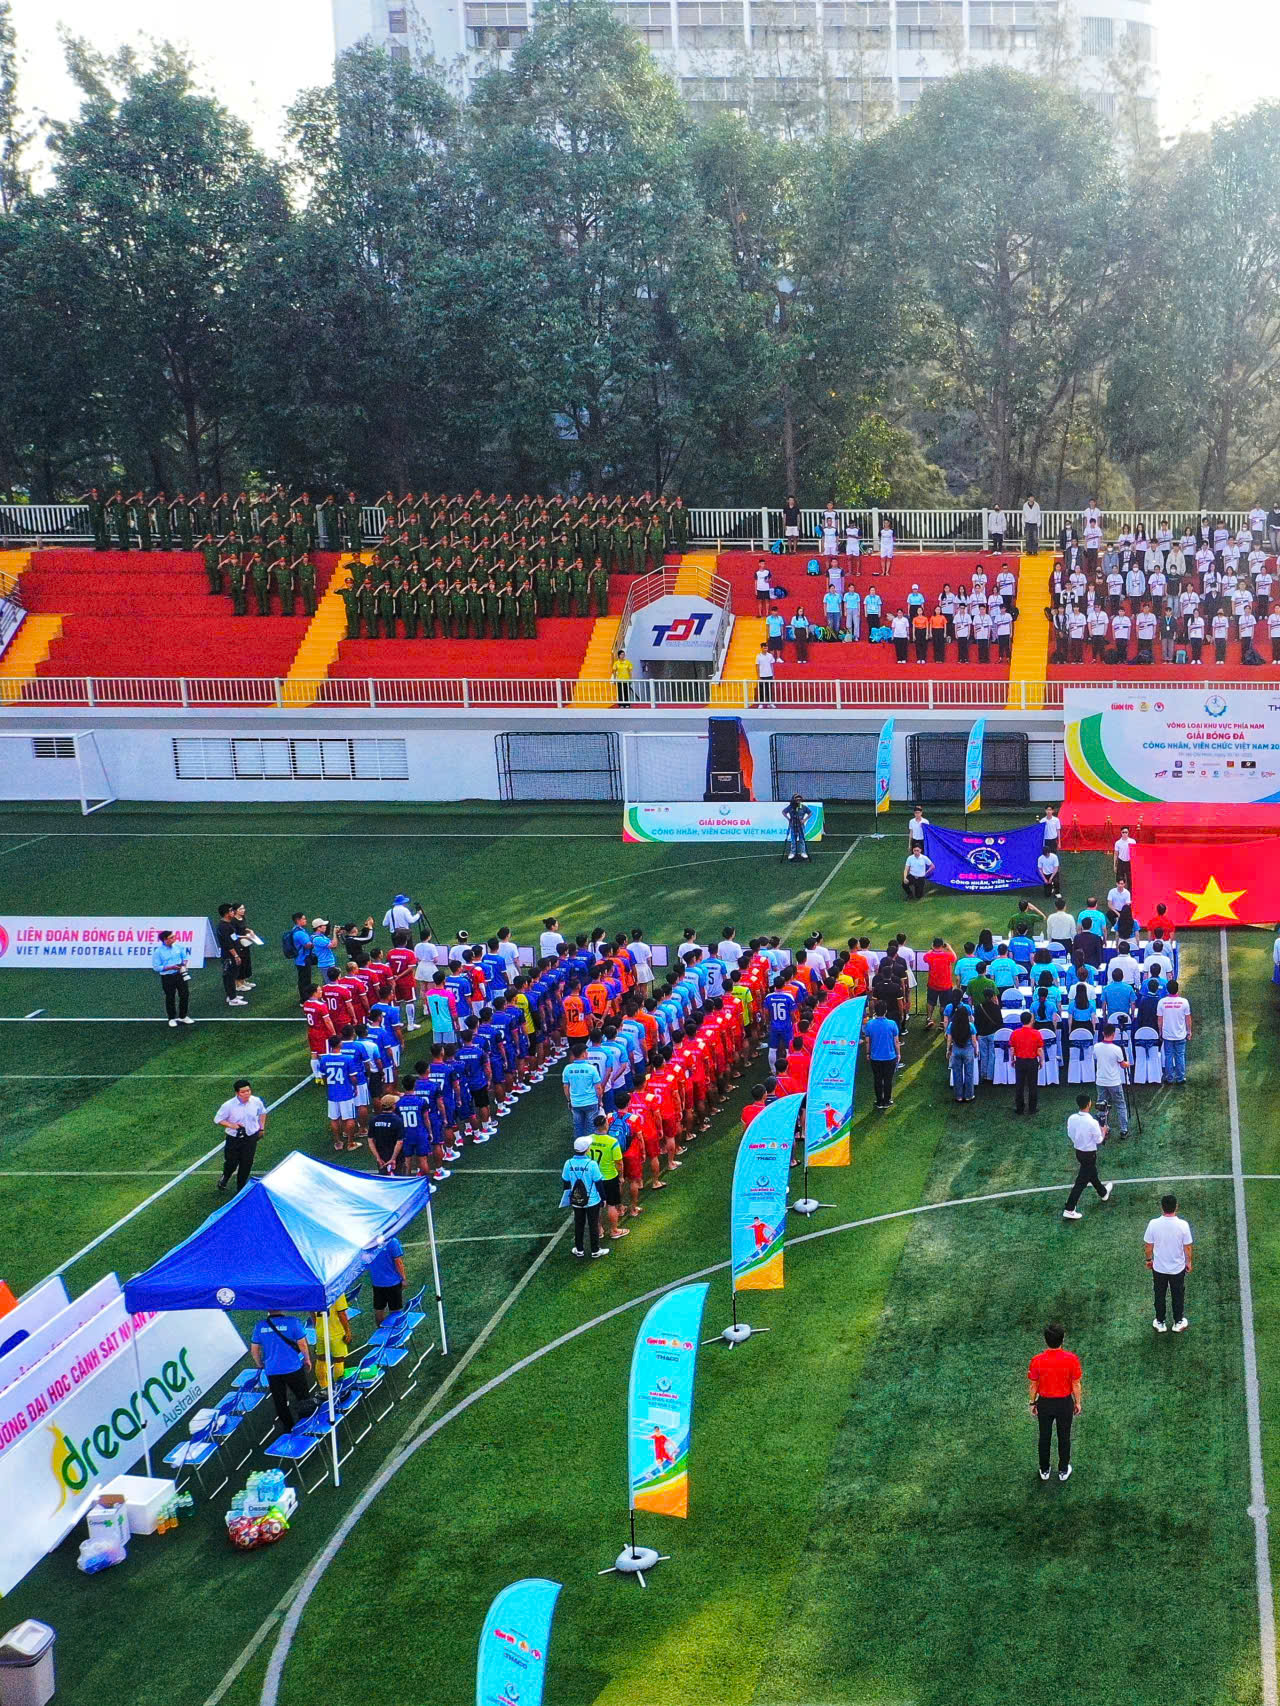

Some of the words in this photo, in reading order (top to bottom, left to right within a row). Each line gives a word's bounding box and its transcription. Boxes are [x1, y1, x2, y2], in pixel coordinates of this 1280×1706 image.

[651, 613, 713, 647] TDT
[1188, 722, 1202, 731] LOẠI
[1218, 722, 1232, 731] VỰC
[1186, 731, 1205, 740] GIẢI
[1206, 732, 1231, 740] BÓNG
[1232, 732, 1245, 740] ĐÁ
[1167, 742, 1191, 751] NHÂN,
[1192, 742, 1212, 750] VIÊN
[1213, 741, 1233, 750] CHỨC
[1235, 742, 1252, 752] VIỆT
[699, 818, 715, 826] GIẢI
[716, 818, 739, 826] BÓNG
[740, 818, 751, 826] ĐÁ
[651, 827, 677, 835] CÔNG
[678, 827, 700, 836] NHÂN,
[701, 827, 719, 835] VIÊN
[720, 827, 742, 835] CHỨC
[743, 828, 760, 836] VIỆT
[17, 926, 43, 942] LIÊN
[46, 926, 79, 942] ĐOÀN
[82, 926, 115, 942] BÓNG
[117, 926, 134, 942] ĐÁ
[16, 946, 40, 955] VIET
[43, 946, 67, 955] NAM
[71, 946, 123, 956] FOOTBALL
[395, 960, 403, 974] 7
[707, 971, 714, 985] 5
[326, 998, 338, 1011] 10
[772, 1002, 786, 1020] 16
[306, 1013, 315, 1026] 8
[567, 1009, 579, 1023] 12
[326, 1067, 345, 1085] 24
[654, 1088, 662, 1104] 6
[401, 1111, 418, 1128] 10
[26, 1395, 49, 1423] ĐẠI
[47, 1374, 71, 1404] HỌC
[70, 1353, 100, 1384] CẢNH
[99, 1331, 120, 1359] SÁT
[162, 1384, 202, 1428] Australia
